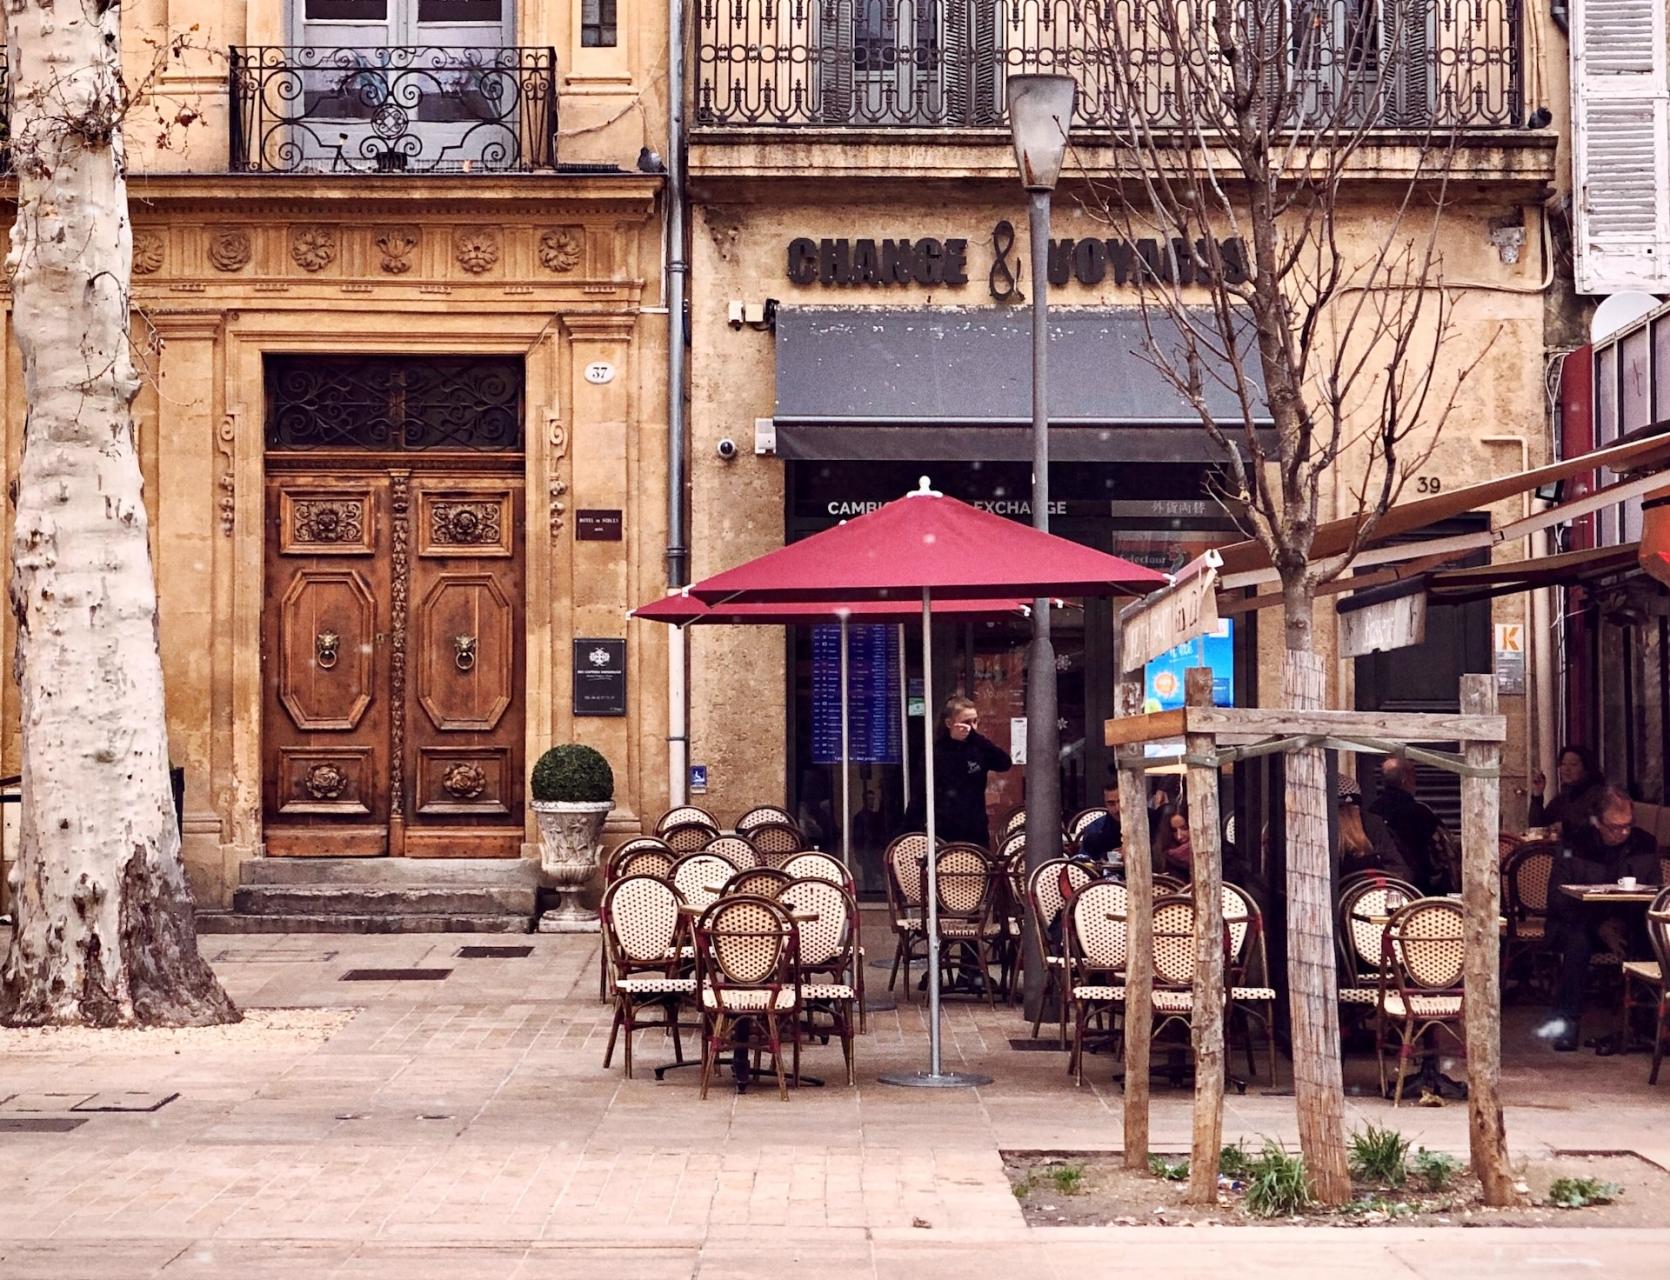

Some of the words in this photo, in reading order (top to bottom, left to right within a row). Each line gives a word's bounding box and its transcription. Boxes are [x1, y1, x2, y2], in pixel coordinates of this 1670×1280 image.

[786, 237, 969, 286] CHANGE
[592, 366, 608, 379] 37
[1416, 476, 1441, 494] 39
[827, 501, 887, 515] CAMBI
[974, 501, 1067, 515] EXCHAGE
